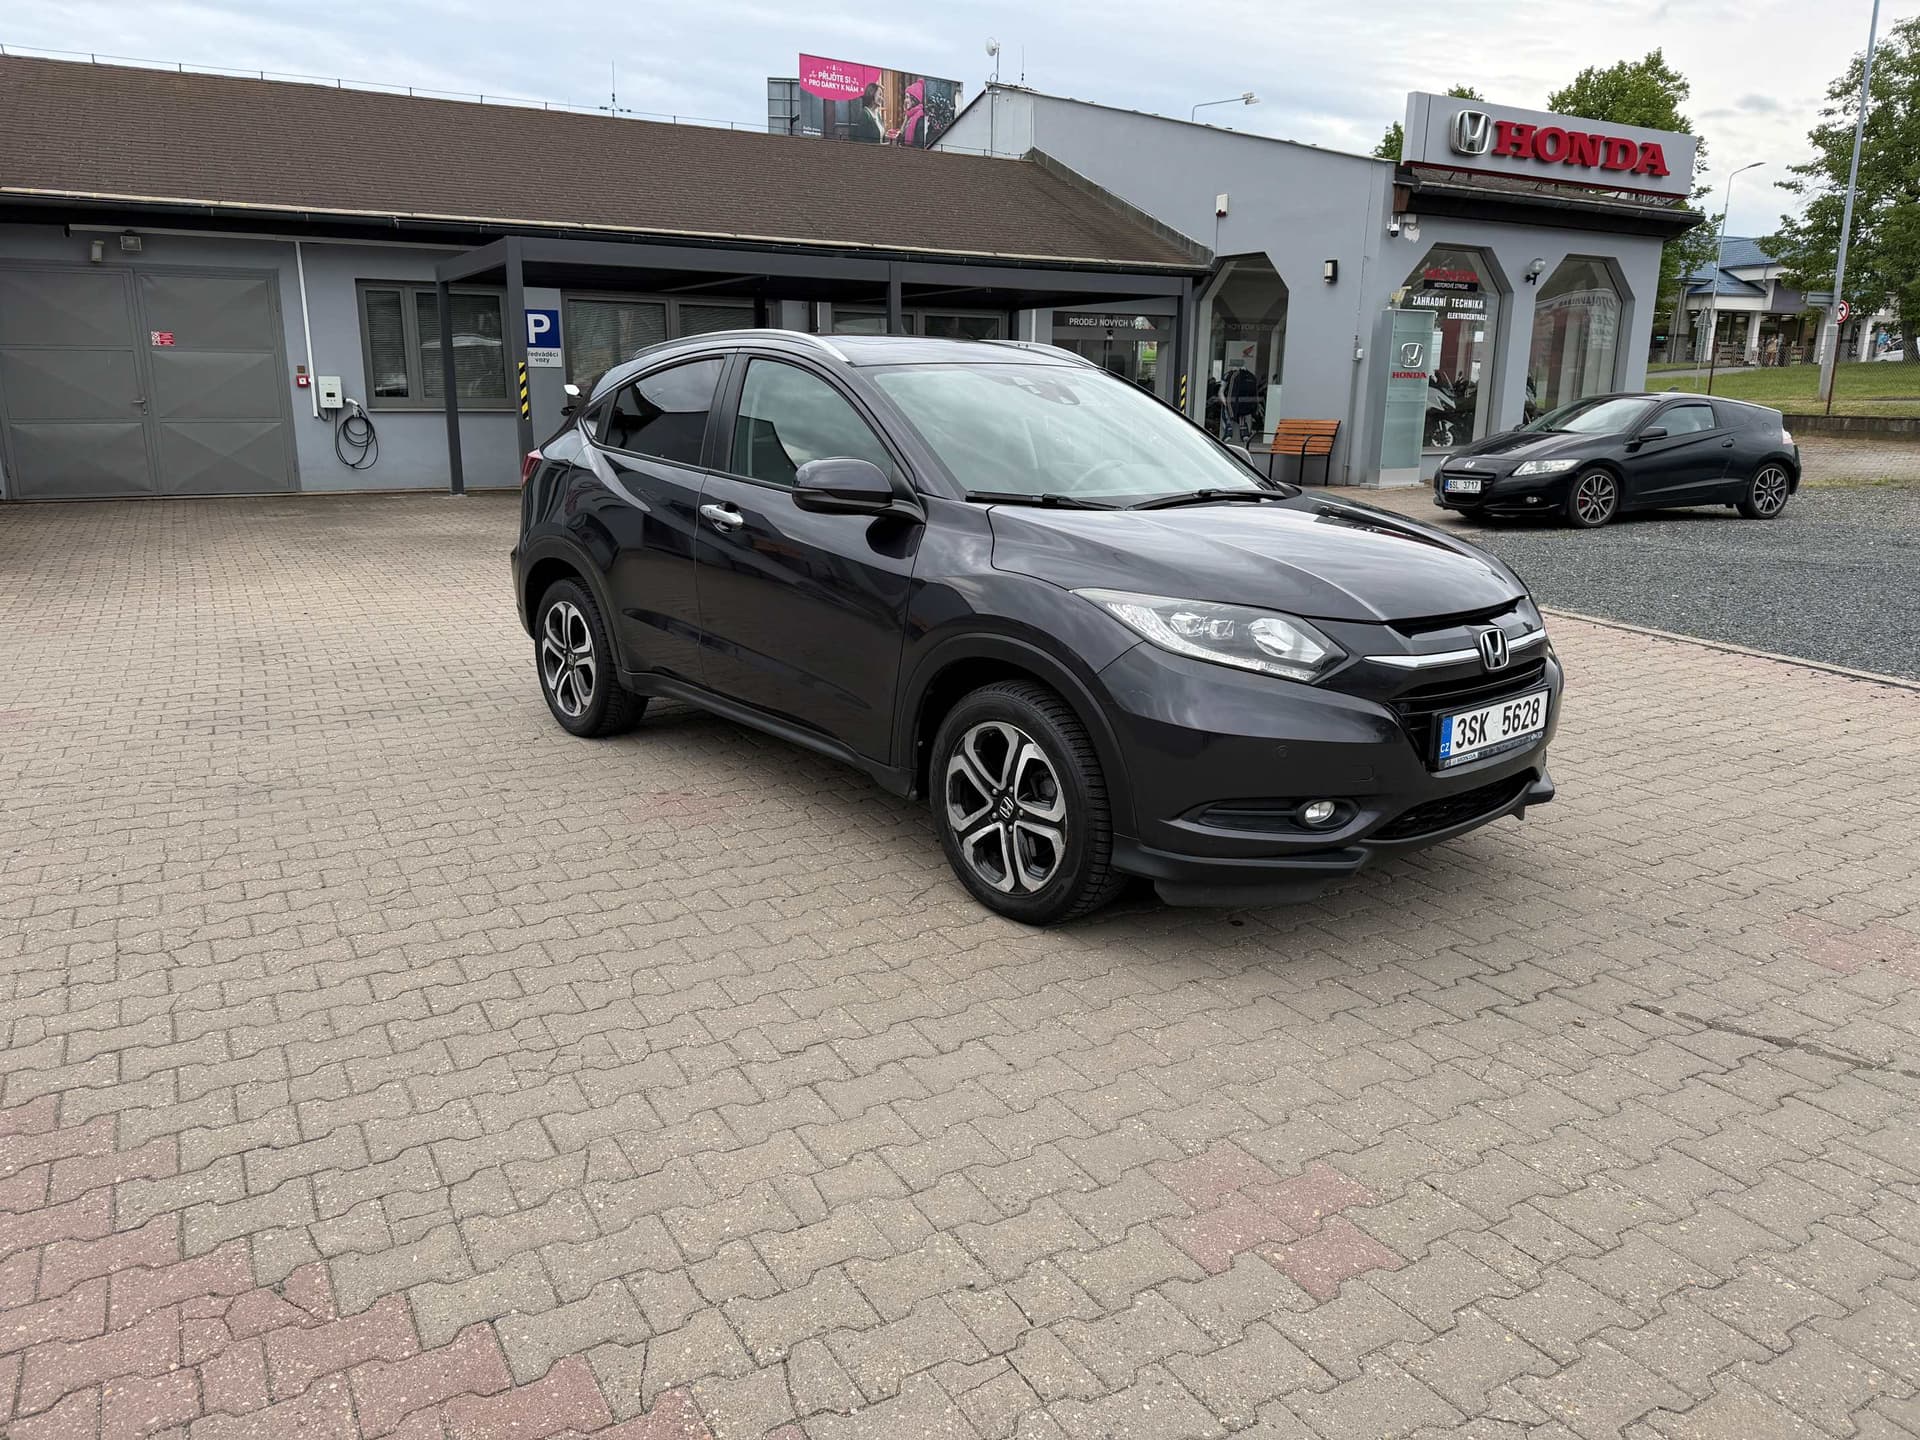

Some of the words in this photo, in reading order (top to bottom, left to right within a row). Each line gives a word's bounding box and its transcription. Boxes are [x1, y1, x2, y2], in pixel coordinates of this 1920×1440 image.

[808, 79, 820, 87] PRO
[821, 81, 840, 89] DÁRKY
[1491, 121, 1670, 176] HONDA
[1412, 296, 1446, 307] ZAHRADNÍ
[1451, 298, 1484, 309] TECHNIKA
[1447, 312, 1488, 321] ELEKTROCENTRÁLY
[1069, 317, 1097, 326] PRODEJ
[1099, 318, 1128, 327] NOVÝCH
[527, 314, 550, 343] P
[1392, 371, 1427, 379] HONDA
[1463, 481, 1479, 489] 3717
[1456, 712, 1489, 748] 3SK
[1502, 698, 1539, 735] 5628
[1441, 743, 1450, 752] CZ
